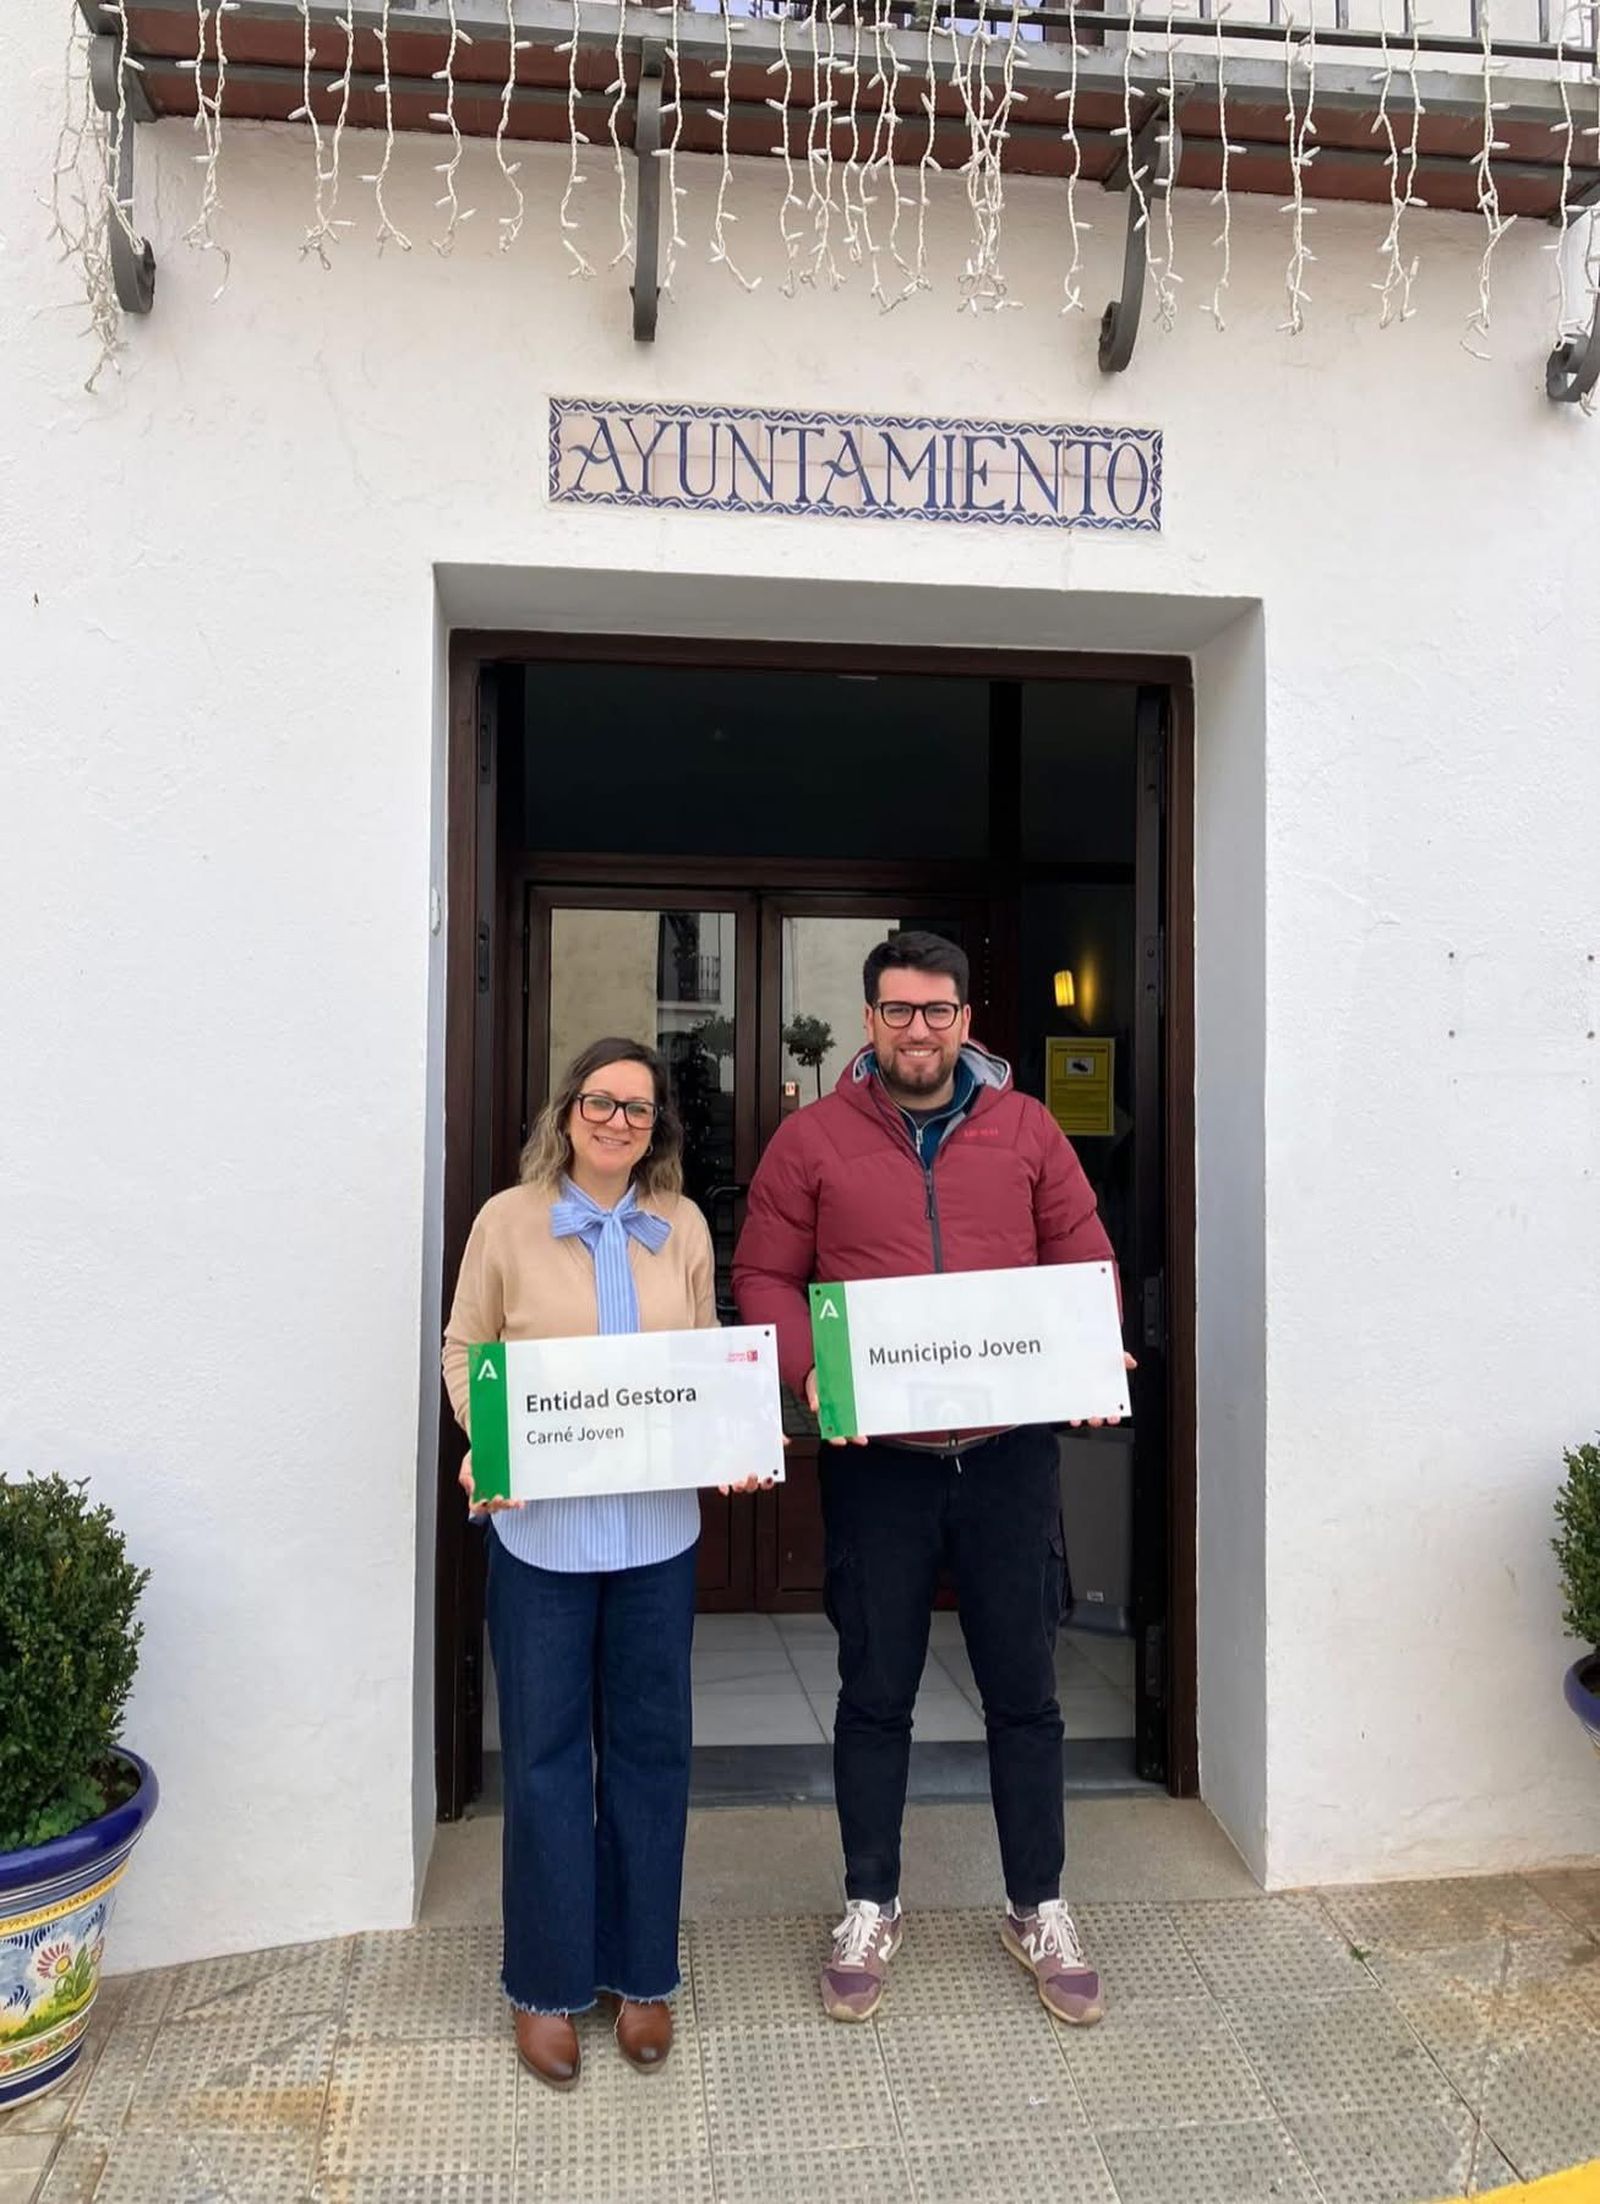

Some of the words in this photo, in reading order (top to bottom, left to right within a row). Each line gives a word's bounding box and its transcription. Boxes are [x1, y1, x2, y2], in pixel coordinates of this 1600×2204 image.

[568, 416, 1149, 516] AYUNTAMIENTO
[868, 1340, 972, 1366] Municipio
[979, 1337, 1041, 1356] Joven
[525, 1389, 609, 1413] Entidad
[615, 1385, 697, 1407] Gestora
[526, 1426, 574, 1446] Carné
[578, 1424, 624, 1442] Joven
